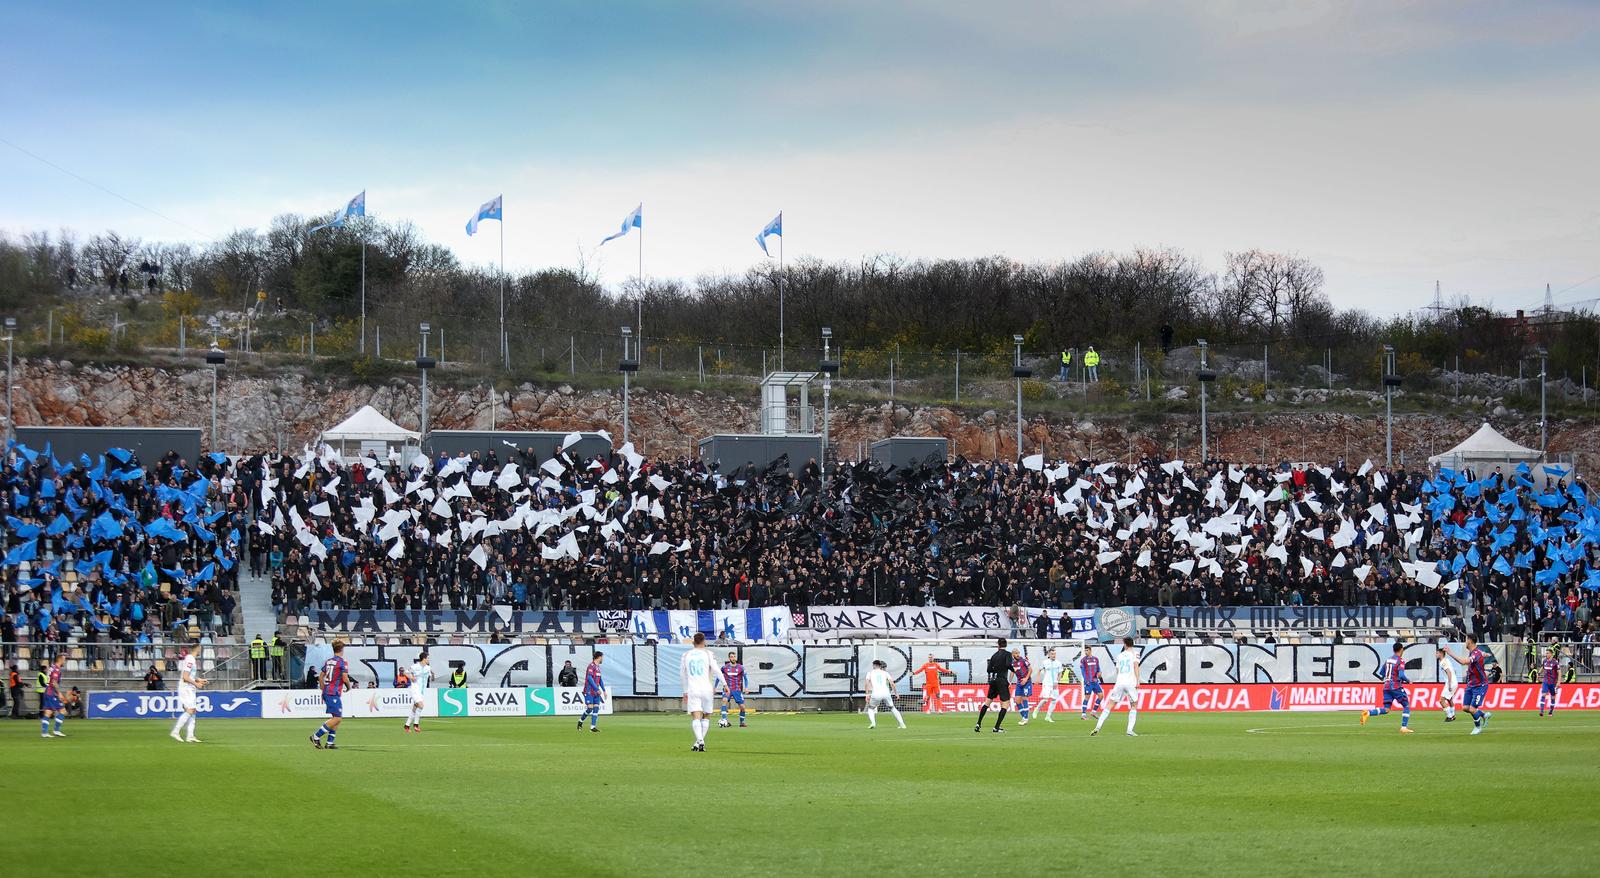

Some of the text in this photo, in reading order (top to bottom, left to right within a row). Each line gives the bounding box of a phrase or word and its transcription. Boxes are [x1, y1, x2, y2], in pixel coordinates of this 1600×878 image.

[317, 610, 382, 633] MA
[394, 610, 443, 632] NE
[833, 610, 980, 633] ARMADA
[1119, 659, 1131, 673] 25
[474, 692, 519, 705] SAVA
[561, 691, 605, 705] SA
[1289, 687, 1376, 704] MARITERM
